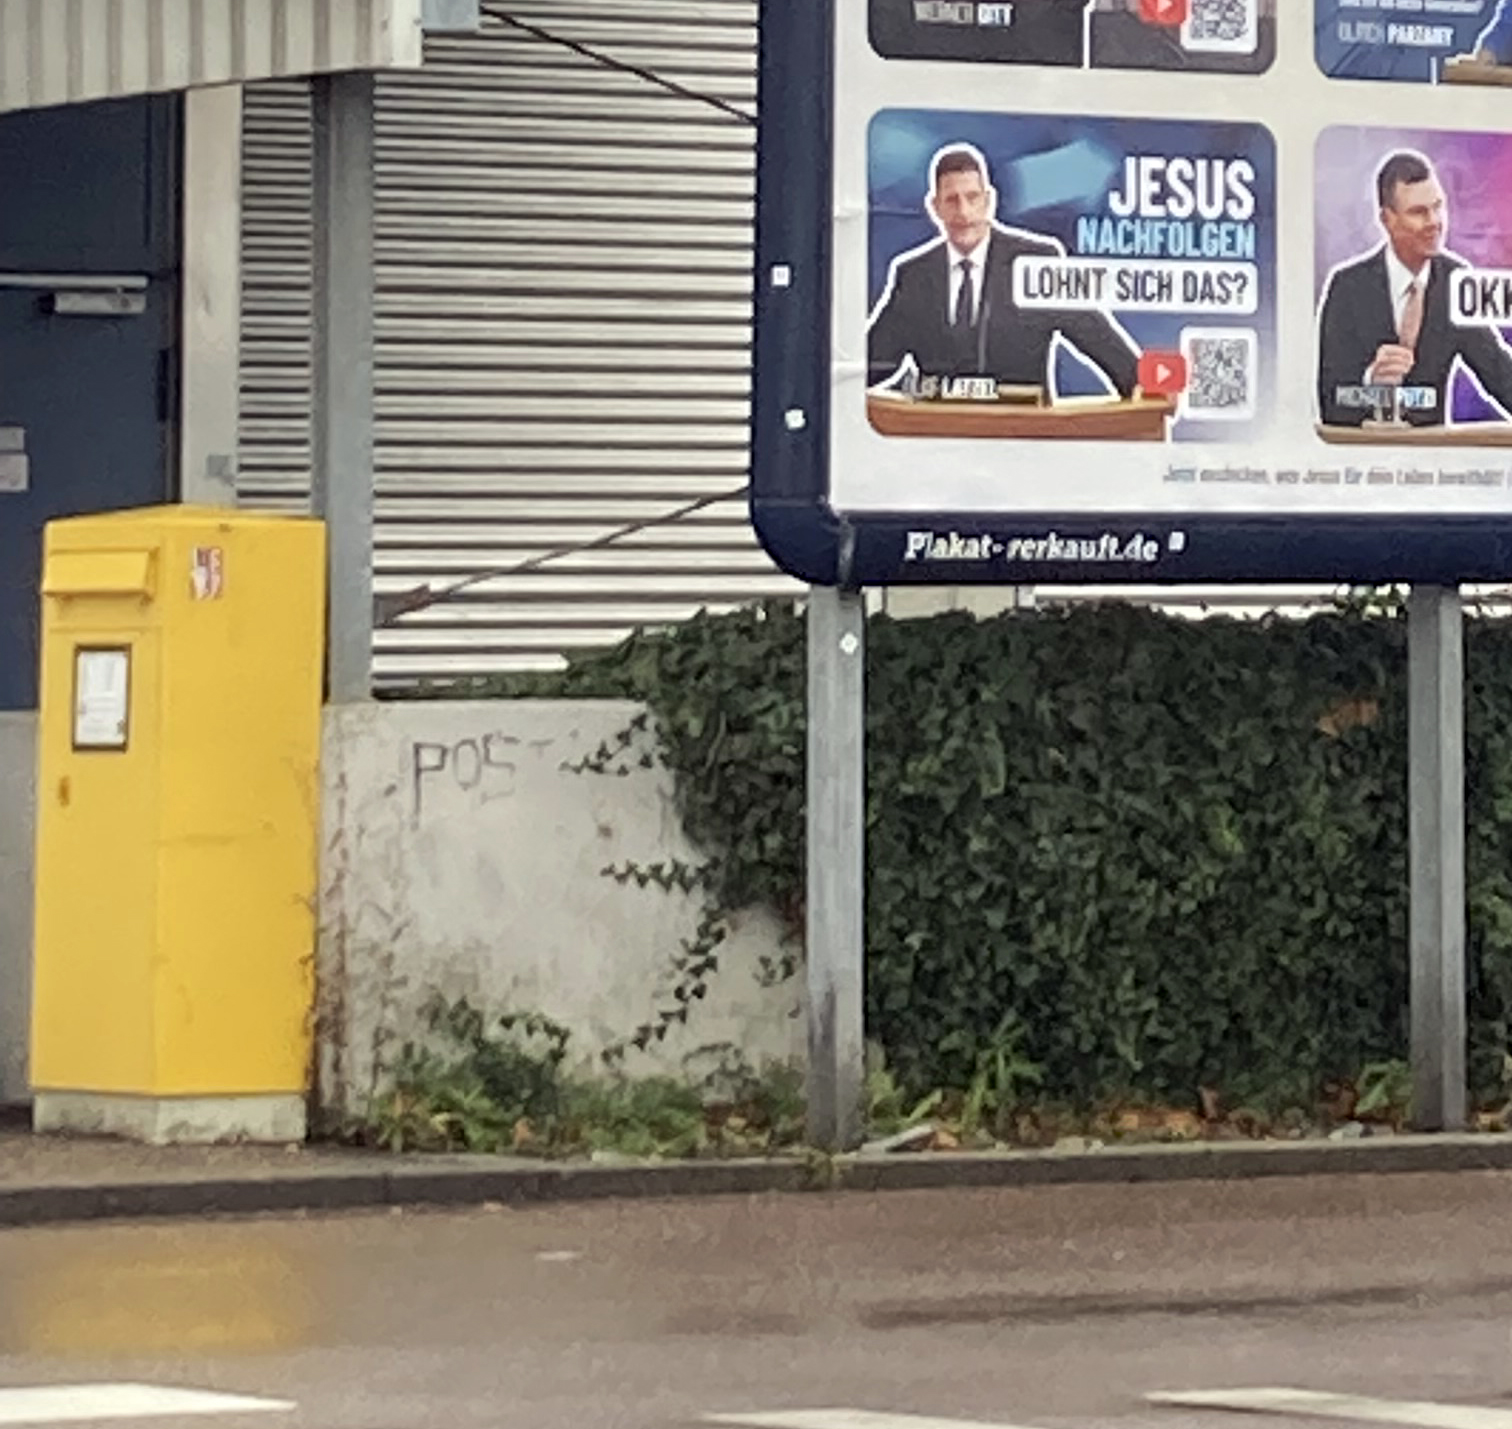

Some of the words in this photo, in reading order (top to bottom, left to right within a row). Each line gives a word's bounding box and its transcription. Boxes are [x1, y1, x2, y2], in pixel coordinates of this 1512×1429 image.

[1108, 155, 1256, 221] JESUS
[1077, 216, 1255, 260] NACHFOLGEN
[1022, 264, 1107, 302] LOHNT
[1116, 268, 1174, 304] SICH
[1182, 271, 1250, 306] DAS?
